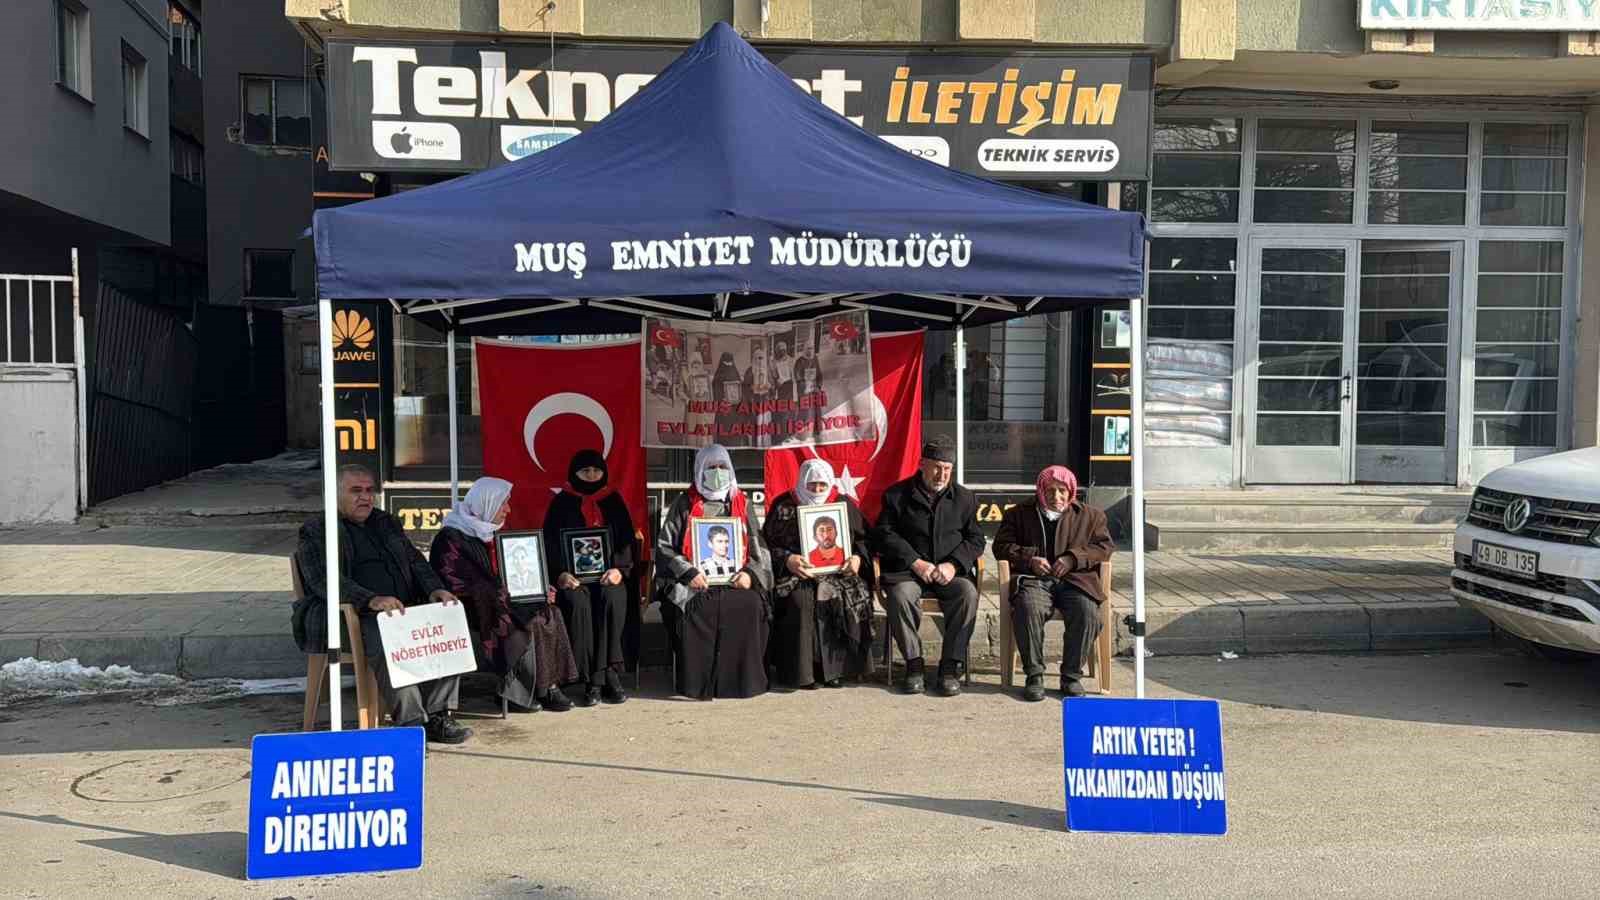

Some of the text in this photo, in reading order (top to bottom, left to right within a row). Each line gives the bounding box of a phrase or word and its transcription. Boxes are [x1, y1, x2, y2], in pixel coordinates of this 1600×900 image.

[886, 67, 1122, 137] İLETİŞİM
[414, 136, 444, 147] iPhone
[983, 145, 1114, 163] TEKNİK SERVİS
[514, 231, 972, 279] MUŞ EMNİYET MÜDÜRLÜĞÜ
[1479, 544, 1490, 562] 49
[1515, 552, 1535, 572] 135
[411, 625, 445, 640] EVLAT
[391, 637, 468, 662] NÖBETİNDEYİZ
[1092, 726, 1138, 756] ARTIK
[1140, 727, 1186, 757] YETER
[271, 755, 394, 799] ANNELER
[1066, 763, 1225, 809] YAKAMIZDAN DÜŞÜN
[264, 800, 407, 855] DİRENİYOR
